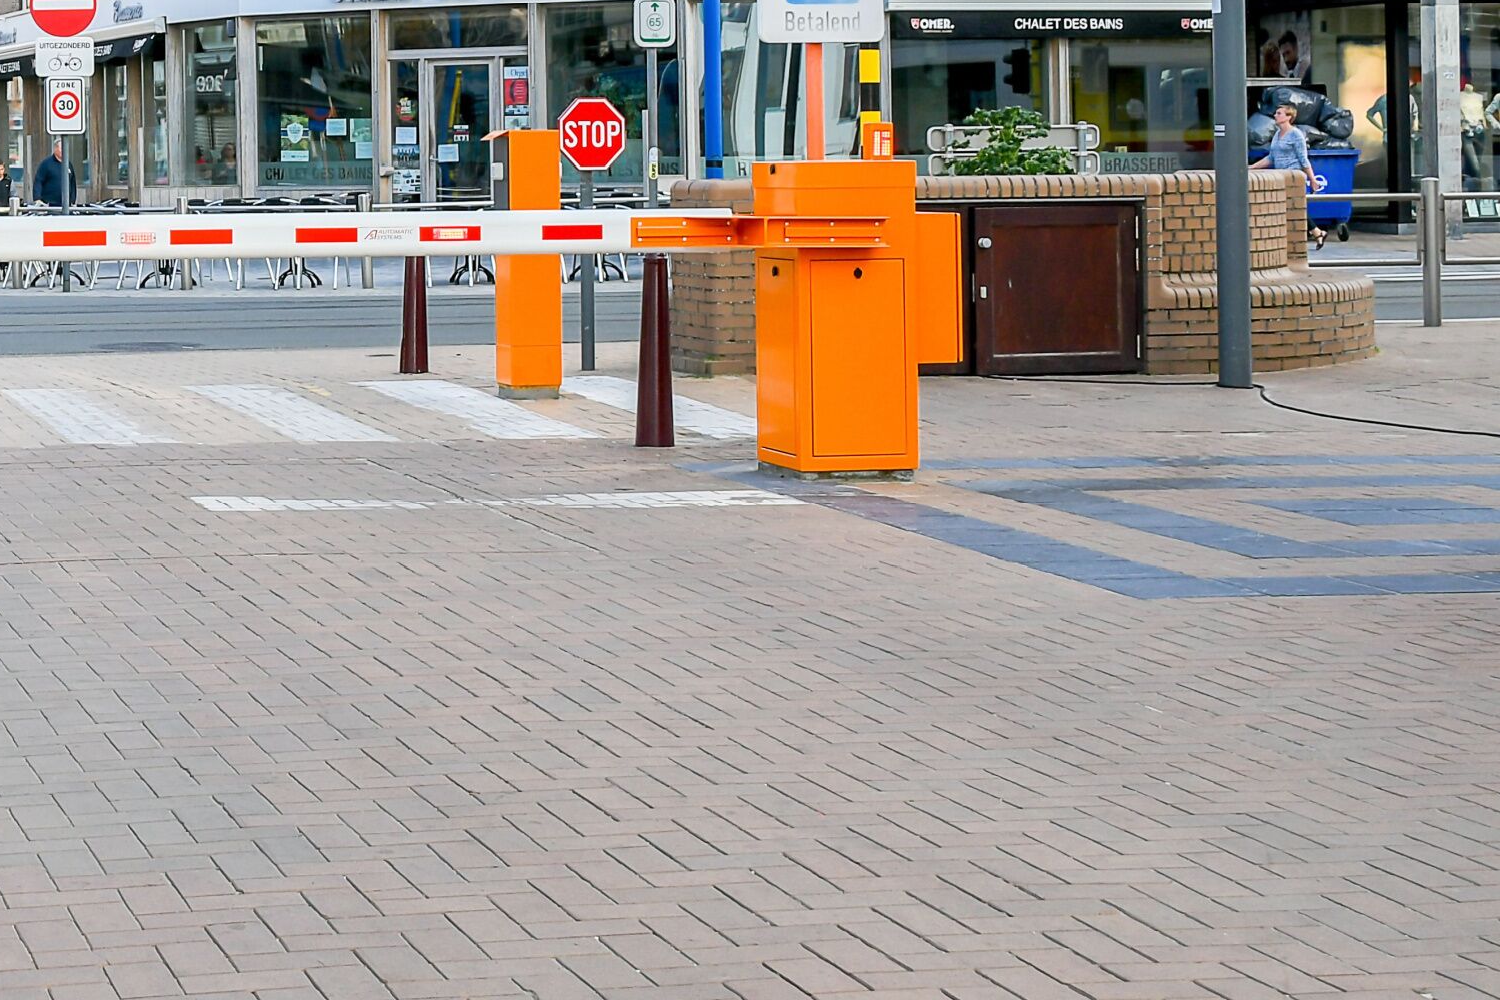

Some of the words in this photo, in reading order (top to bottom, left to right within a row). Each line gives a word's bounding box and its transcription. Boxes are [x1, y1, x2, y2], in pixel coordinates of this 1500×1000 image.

[648, 18, 662, 27] 65
[784, 11, 860, 32] Betalend
[1014, 18, 1061, 30] CHALET
[1064, 18, 1088, 30] DES
[1090, 18, 1124, 30] BAINS
[58, 100, 74, 110] 30
[564, 120, 620, 148] STOP
[1104, 157, 1179, 172] BRASSERIE
